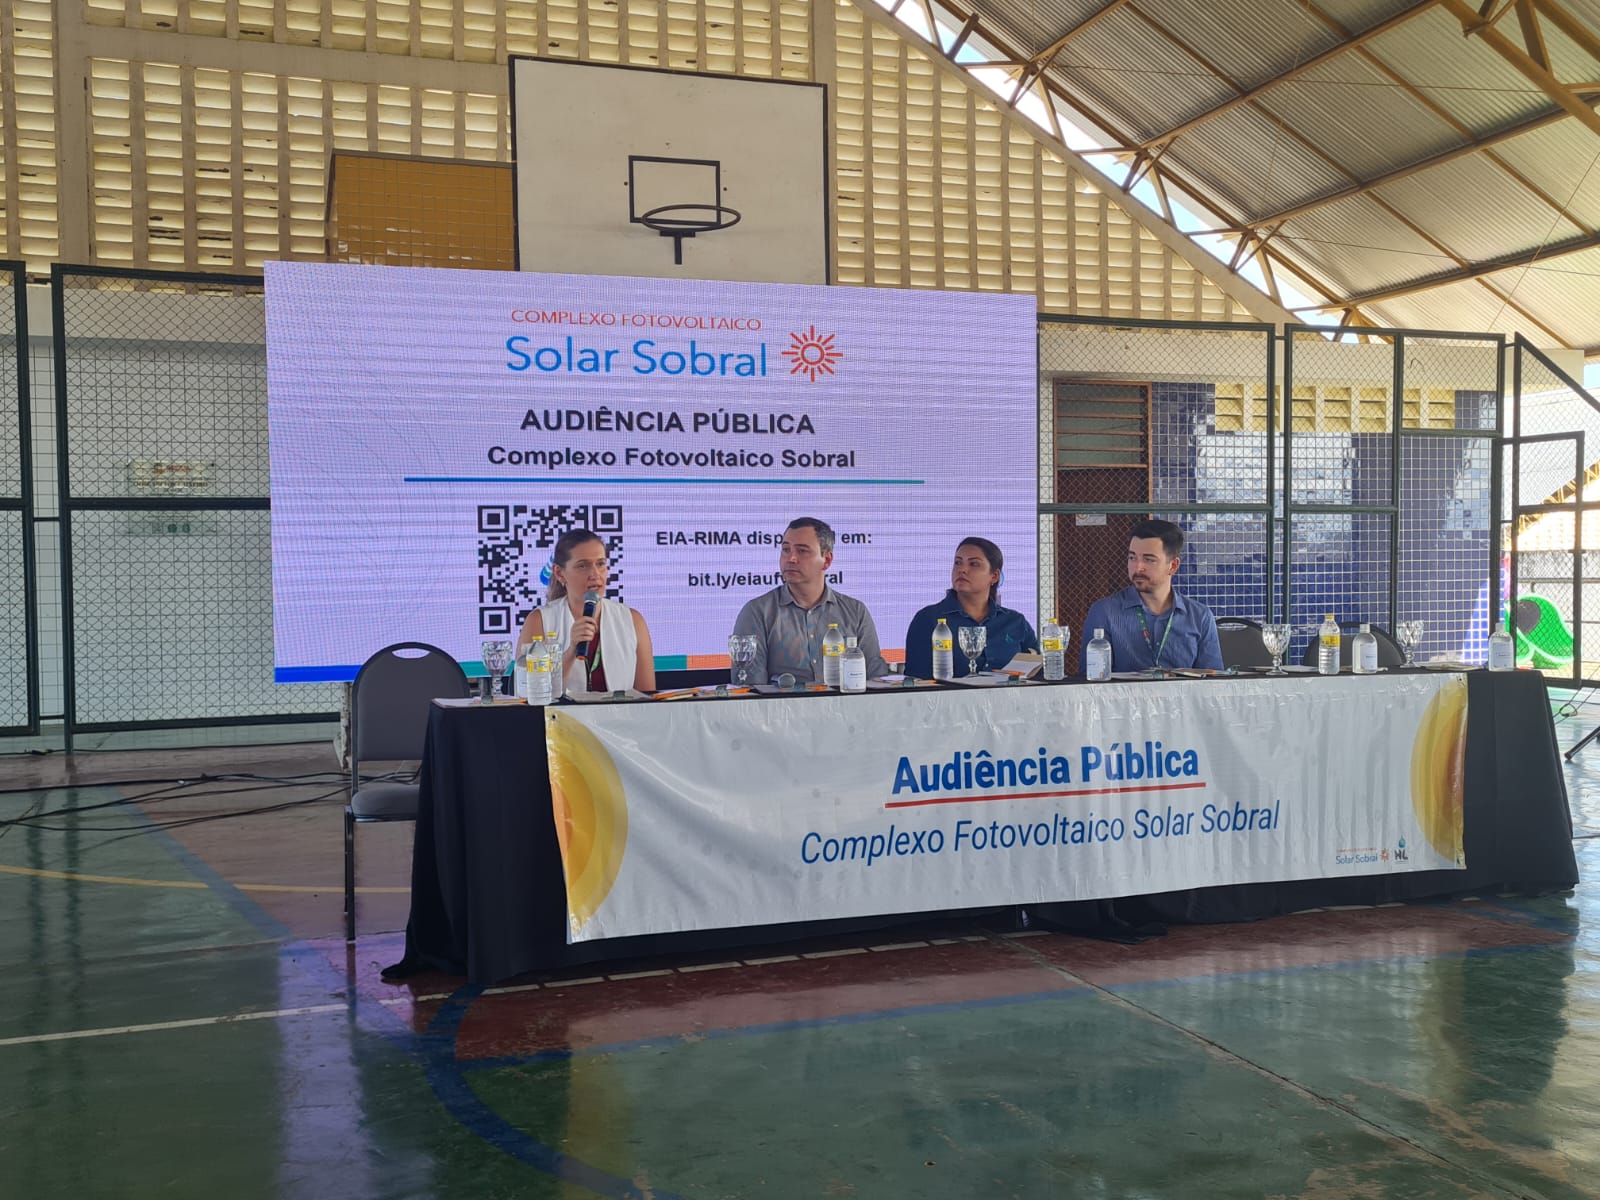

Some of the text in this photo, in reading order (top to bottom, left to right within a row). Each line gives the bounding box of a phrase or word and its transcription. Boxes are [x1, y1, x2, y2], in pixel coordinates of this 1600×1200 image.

[511, 309, 762, 331] COMPLEXO FOTOVOLTAICO
[505, 335, 767, 377] Solar Sobral
[520, 406, 816, 435] AUDIÊNCIA PÚBLICA
[487, 446, 856, 470] Complexo Fotovoltaico Sobral
[655, 530, 742, 546] EIA-RIMA
[841, 532, 873, 545] em:
[891, 740, 1200, 795] Audiência Pública
[801, 799, 1280, 867] Complexo Fotovoltaico Solar Sobral
[1335, 853, 1378, 865] Solar Sobral
